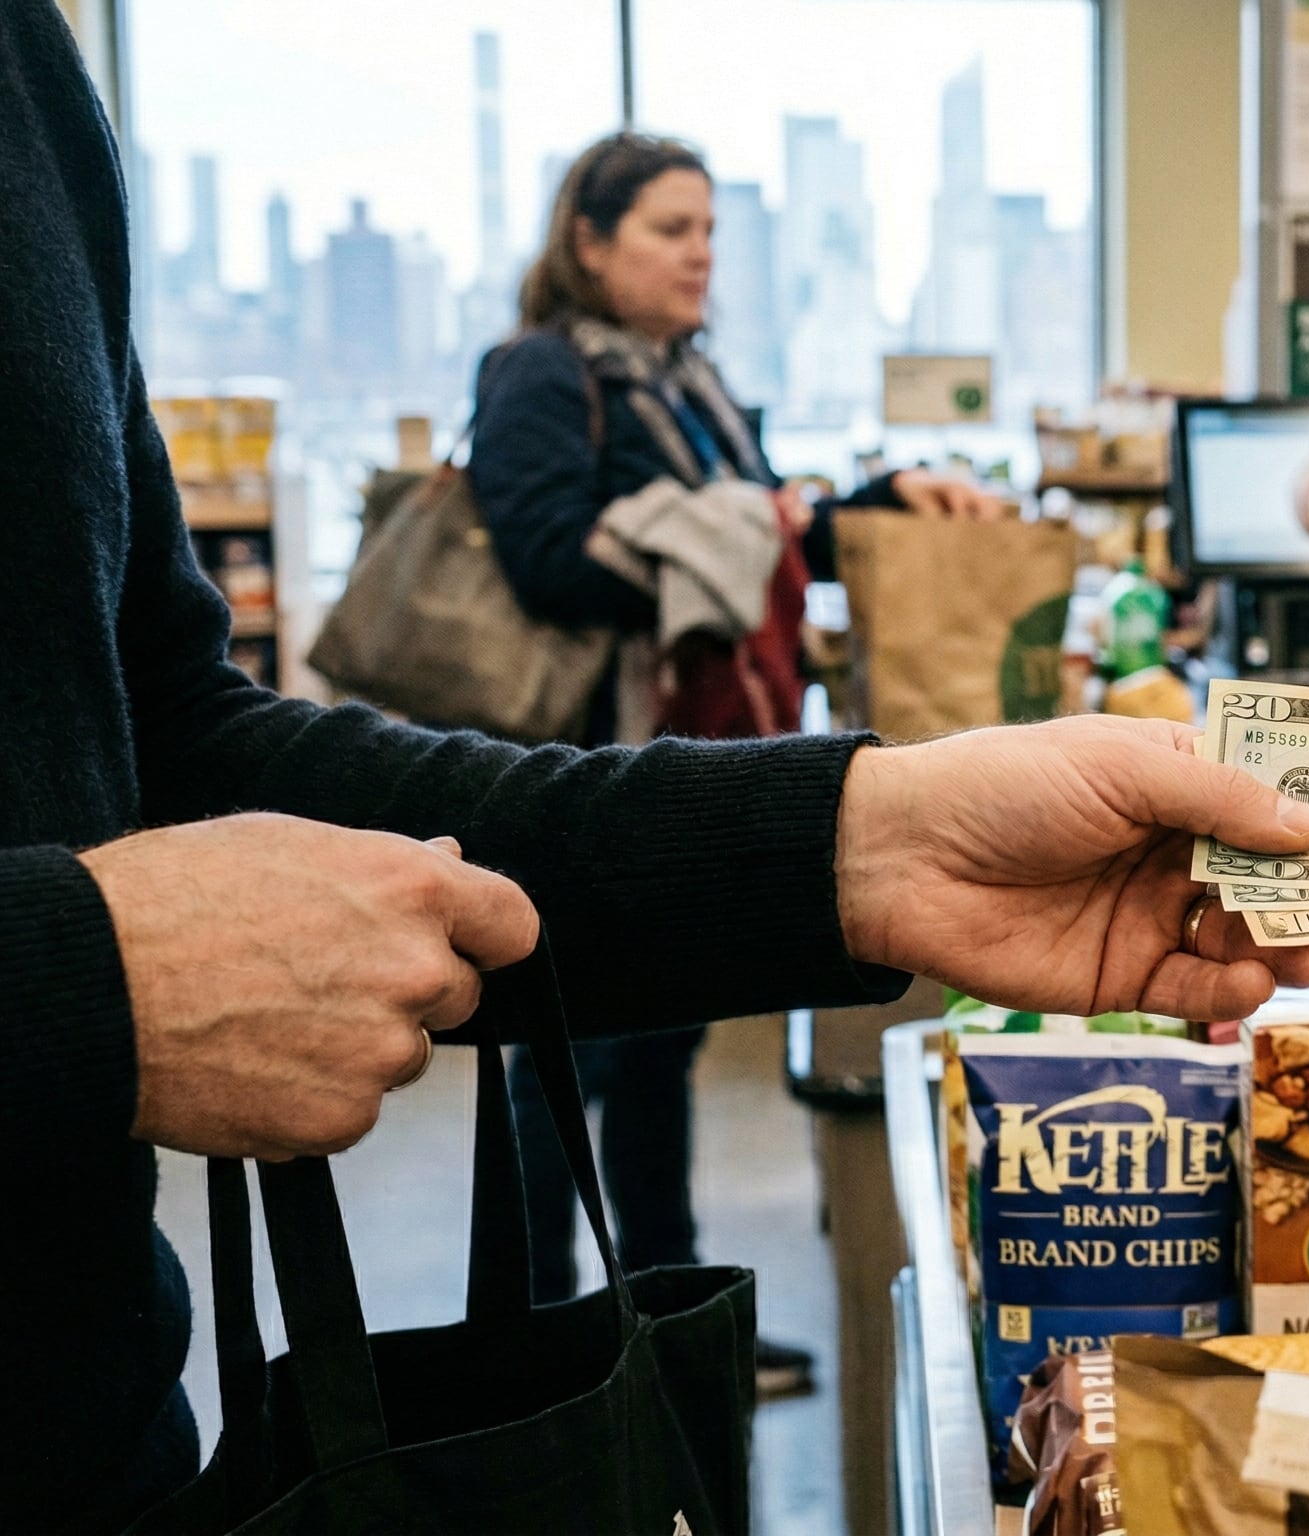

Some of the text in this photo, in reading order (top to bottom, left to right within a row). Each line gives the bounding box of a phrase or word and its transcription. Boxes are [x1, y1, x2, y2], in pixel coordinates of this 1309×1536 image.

[1223, 693, 1292, 722] 20
[1207, 854, 1306, 880] 20
[992, 1084, 1229, 1196] KETTLE
[1064, 1205, 1161, 1228] BRAND
[999, 1236, 1222, 1267] BRAND CHIPS
